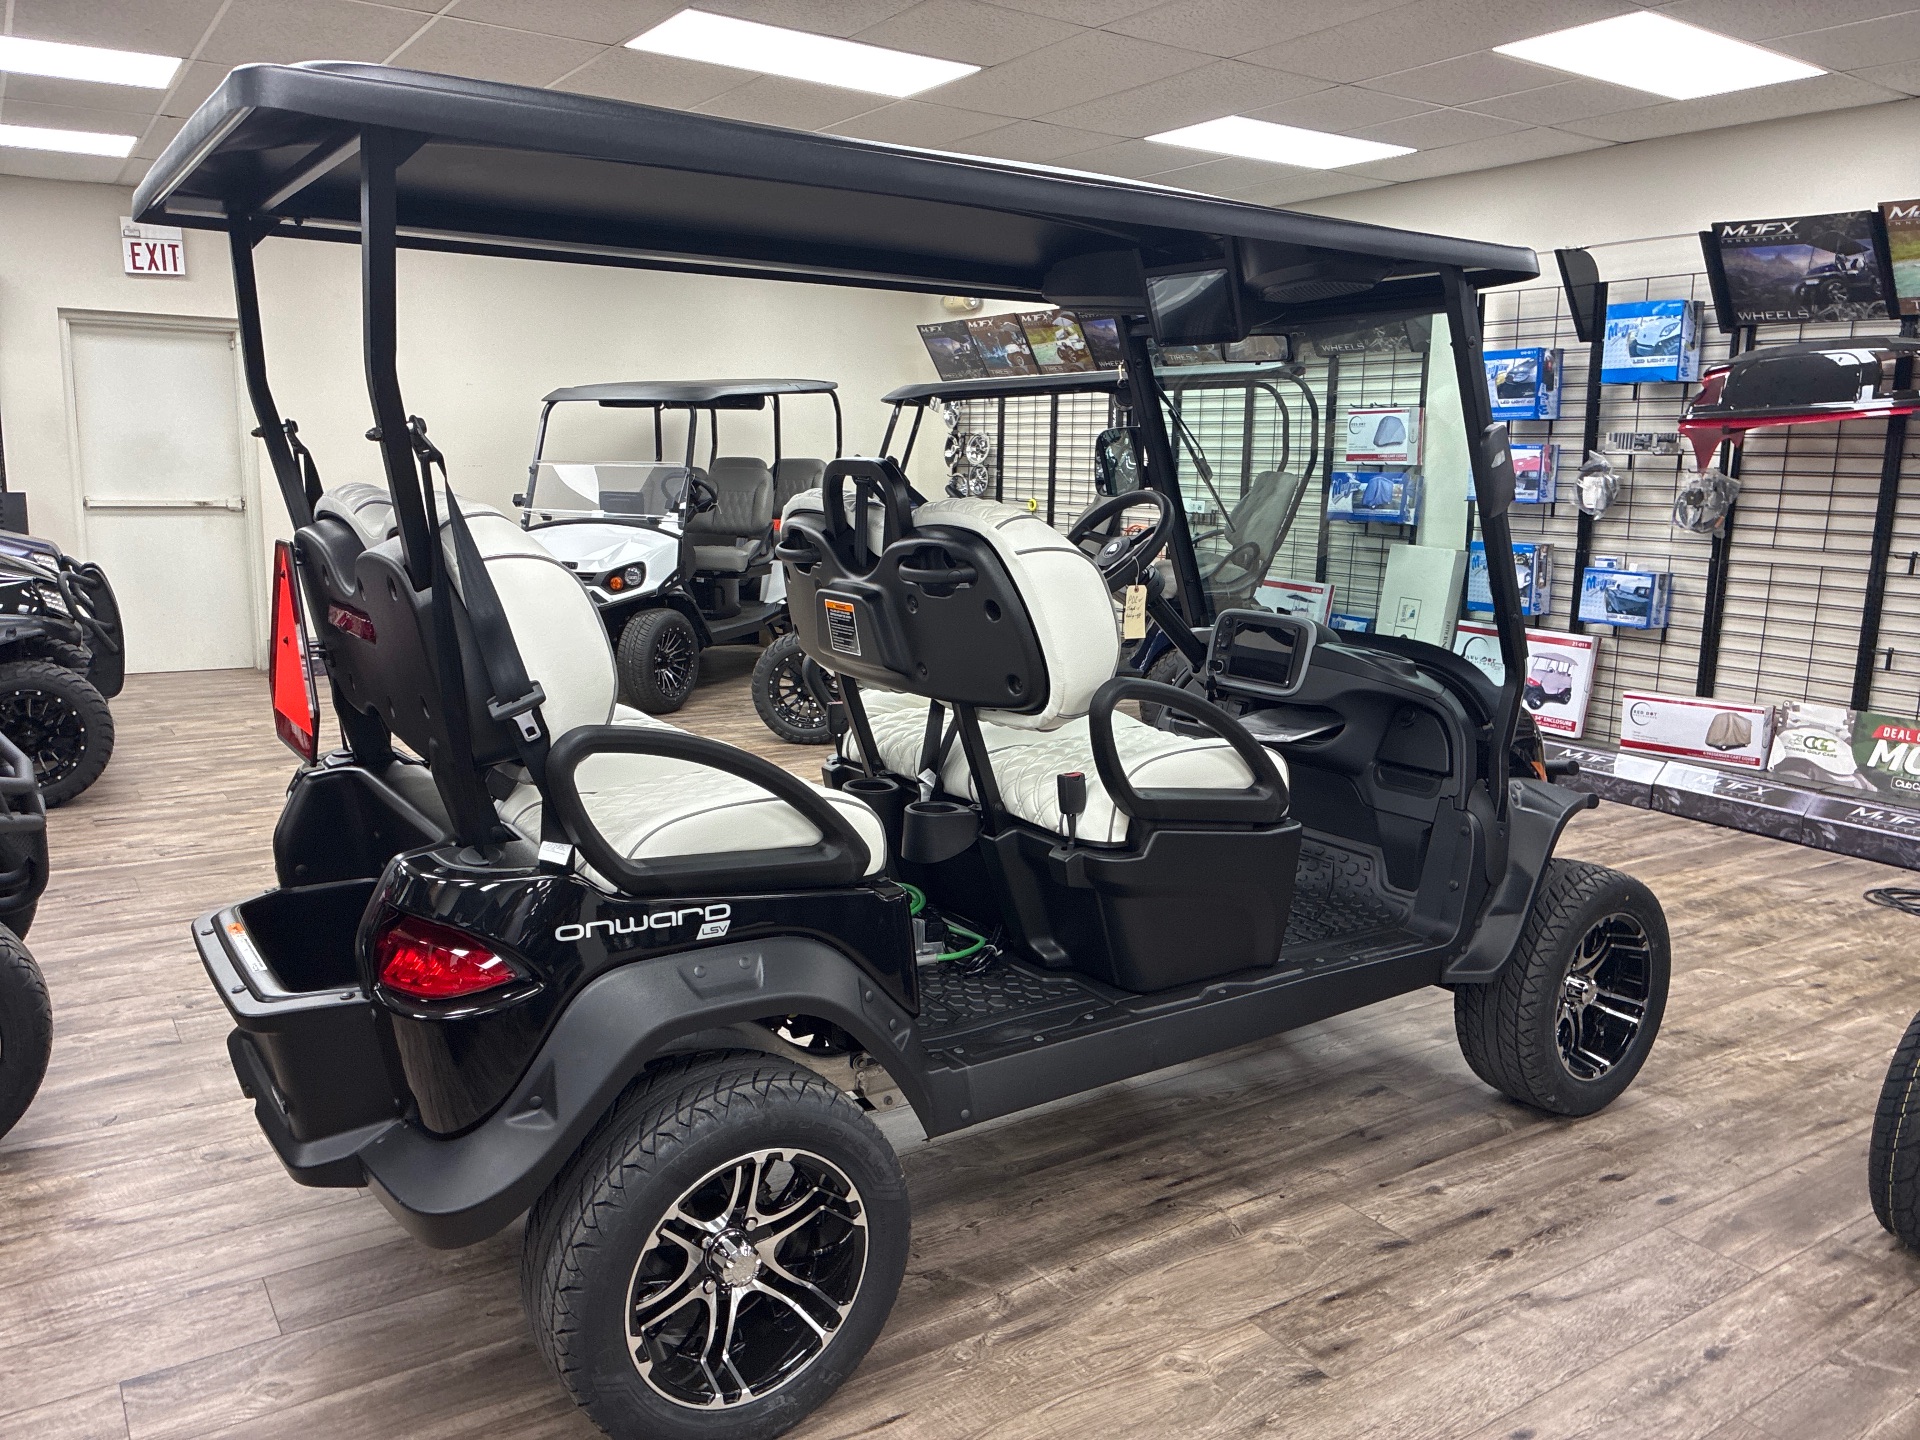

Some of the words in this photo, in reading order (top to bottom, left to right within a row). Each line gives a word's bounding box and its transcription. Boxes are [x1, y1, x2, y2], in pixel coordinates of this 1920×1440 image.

[1721, 234, 1799, 244] INNOVATIVE
[130, 242, 180, 272] EXIT
[1737, 310, 1810, 321] WHEELS
[1321, 342, 1365, 351] WHEELS
[1543, 717, 1572, 726] ENCLOSURE
[1883, 727, 1911, 741] DEAL
[1558, 748, 1615, 766] MJF
[1895, 779, 1912, 789] Club
[1850, 806, 1920, 826] MJF
[702, 924, 728, 936] LSV
